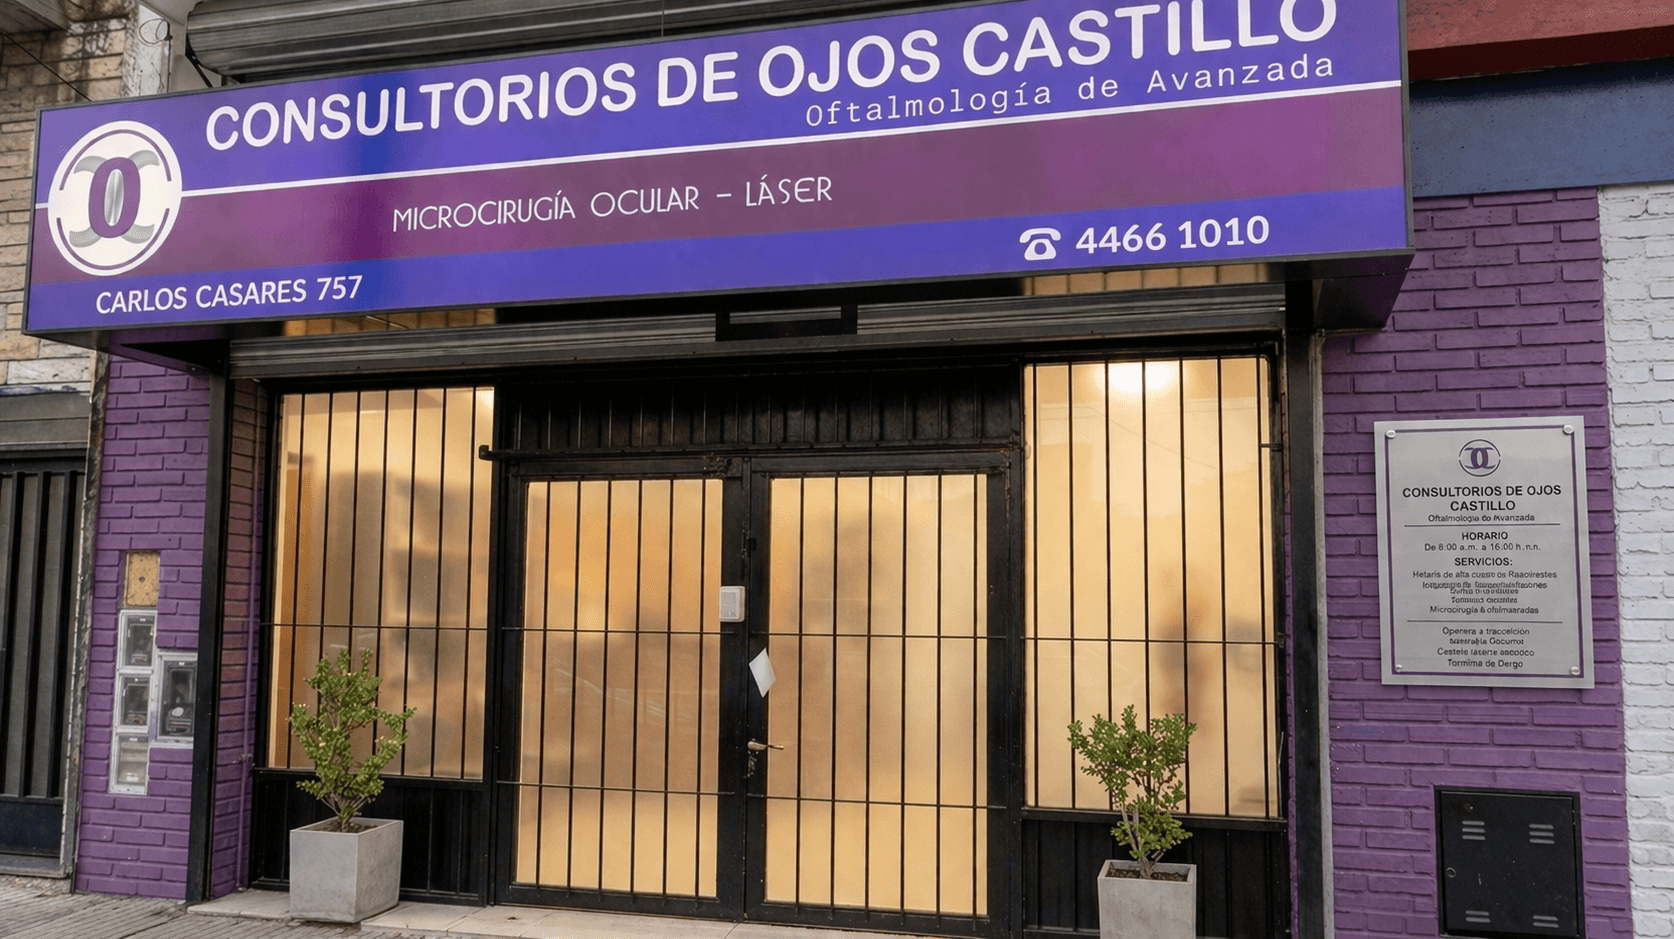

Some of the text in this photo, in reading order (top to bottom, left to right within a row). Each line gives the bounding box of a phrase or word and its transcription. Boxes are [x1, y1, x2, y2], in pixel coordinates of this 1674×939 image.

[205, 0, 1337, 151] CONSULTORIOS DE OJOS CASTILLO
[805, 53, 1333, 127] Oftalmología de Avanzada
[393, 189, 577, 232] MICROCIRUGÍA
[590, 186, 699, 217] OCULAR
[745, 174, 833, 208] LÁSER
[1075, 216, 1270, 254] 4466 1010
[96, 275, 363, 314] CARLOS CASARES 757
[1402, 484, 1562, 498] CONSULTORIOS DE OJOS
[1450, 500, 1516, 512] CASTILLO
[1461, 531, 1509, 541] HORARIO
[1424, 543, 1436, 552] De
[1454, 557, 1513, 567] SERVICIOS:
[1443, 571, 1454, 579] de
